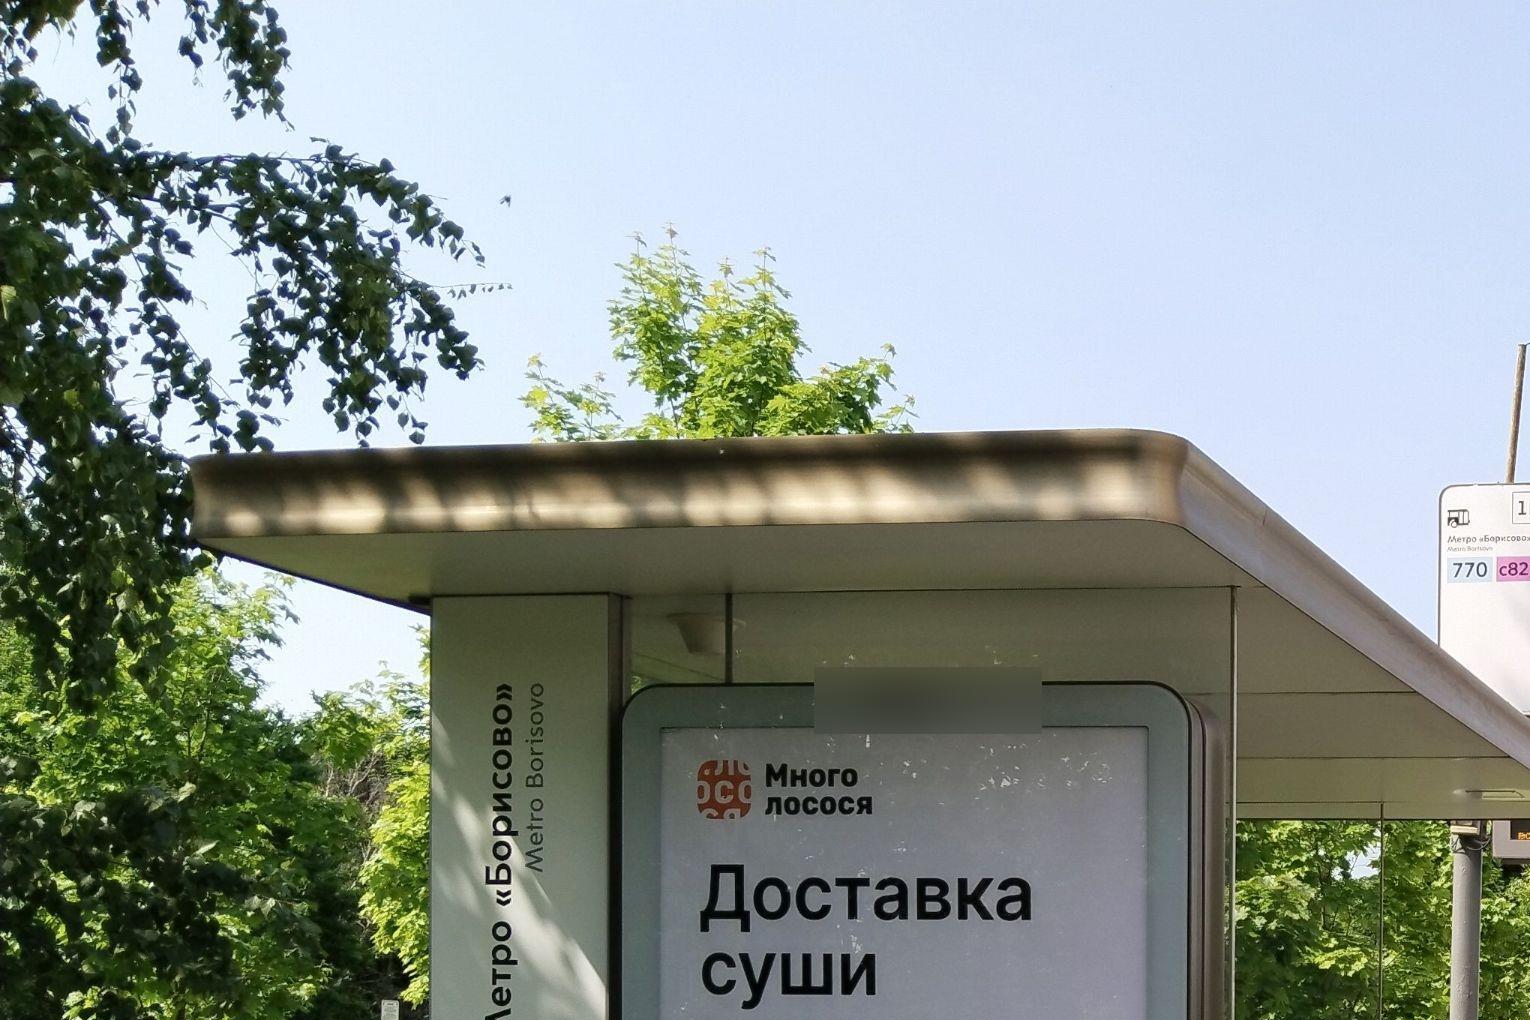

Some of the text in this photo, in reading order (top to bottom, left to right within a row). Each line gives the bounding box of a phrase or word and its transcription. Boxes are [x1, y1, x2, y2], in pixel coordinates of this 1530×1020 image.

[1447, 535, 1477, 544] Метро
[1453, 561, 1487, 578] 770
[485, 683, 518, 907] «Борисово»
[525, 682, 544, 872] Metro Borisovo
[765, 763, 859, 788] Много
[765, 795, 873, 816] лосося
[700, 864, 1033, 932] Доставка
[701, 952, 877, 1010] суши
